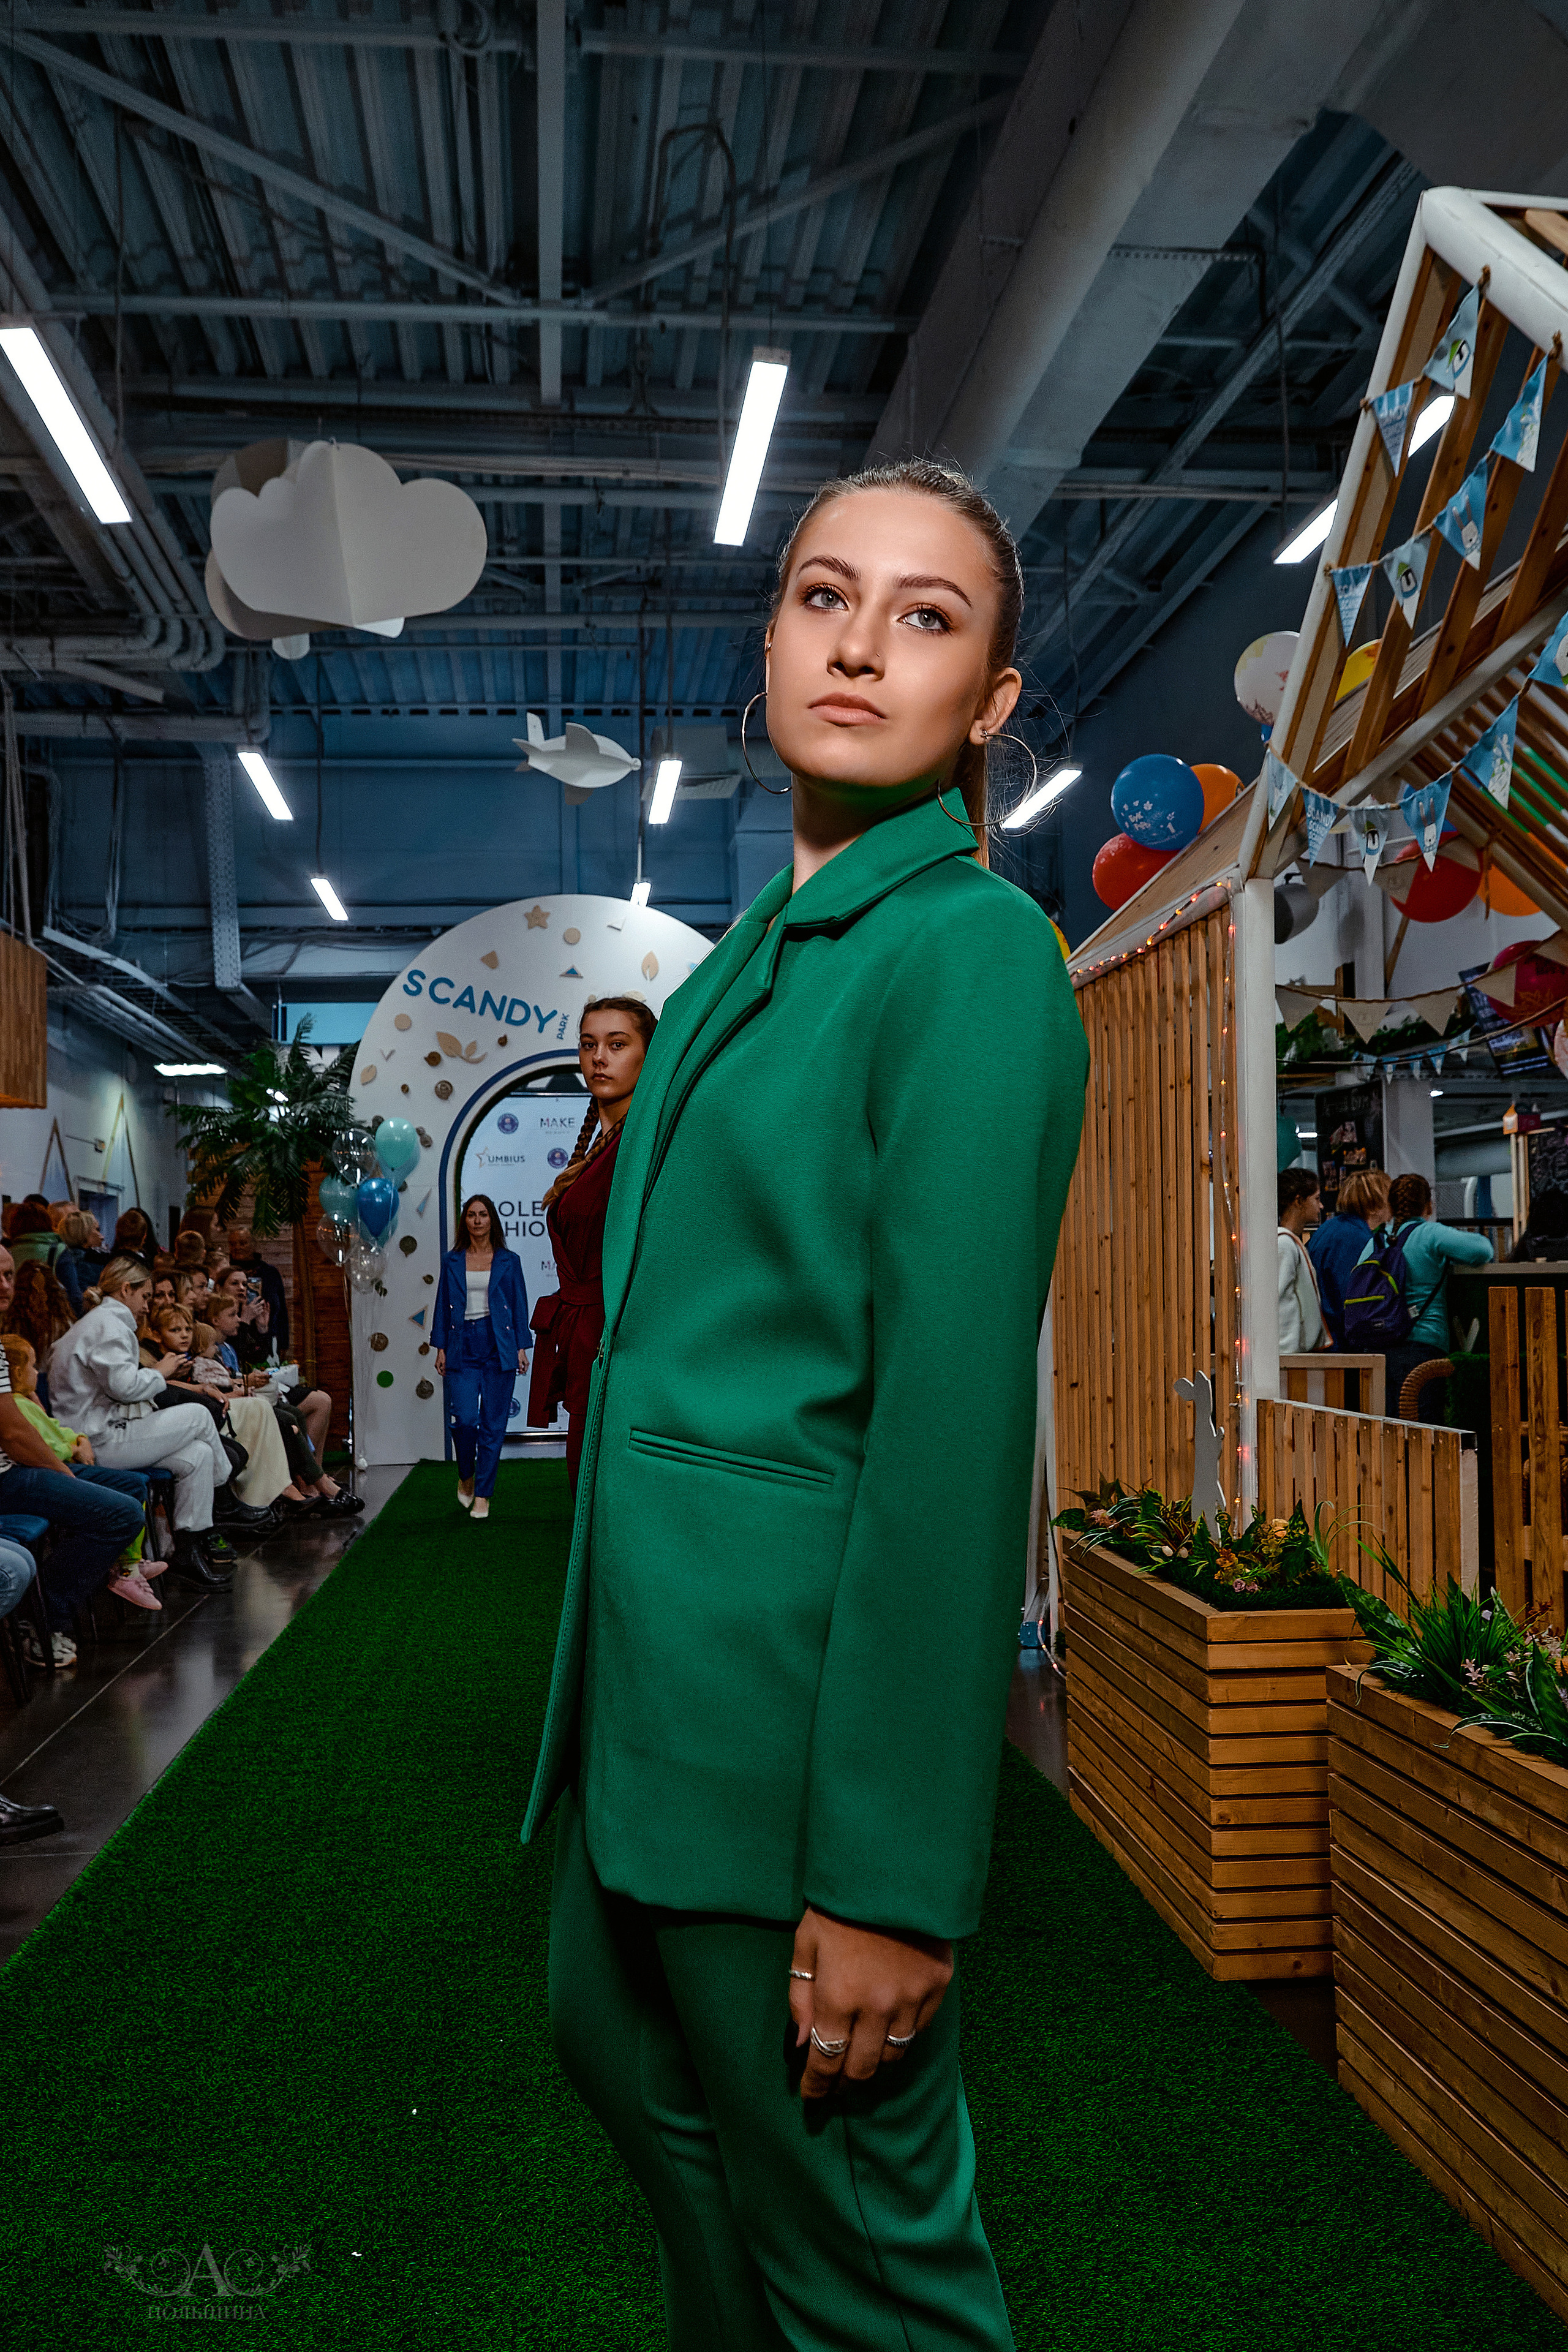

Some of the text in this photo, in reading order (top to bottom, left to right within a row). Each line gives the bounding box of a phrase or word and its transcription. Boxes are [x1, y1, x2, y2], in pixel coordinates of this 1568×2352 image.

[403, 970, 557, 1033] SCANDY
[557, 1013, 570, 1039] PARK
[540, 1118, 575, 1128] MAKE
